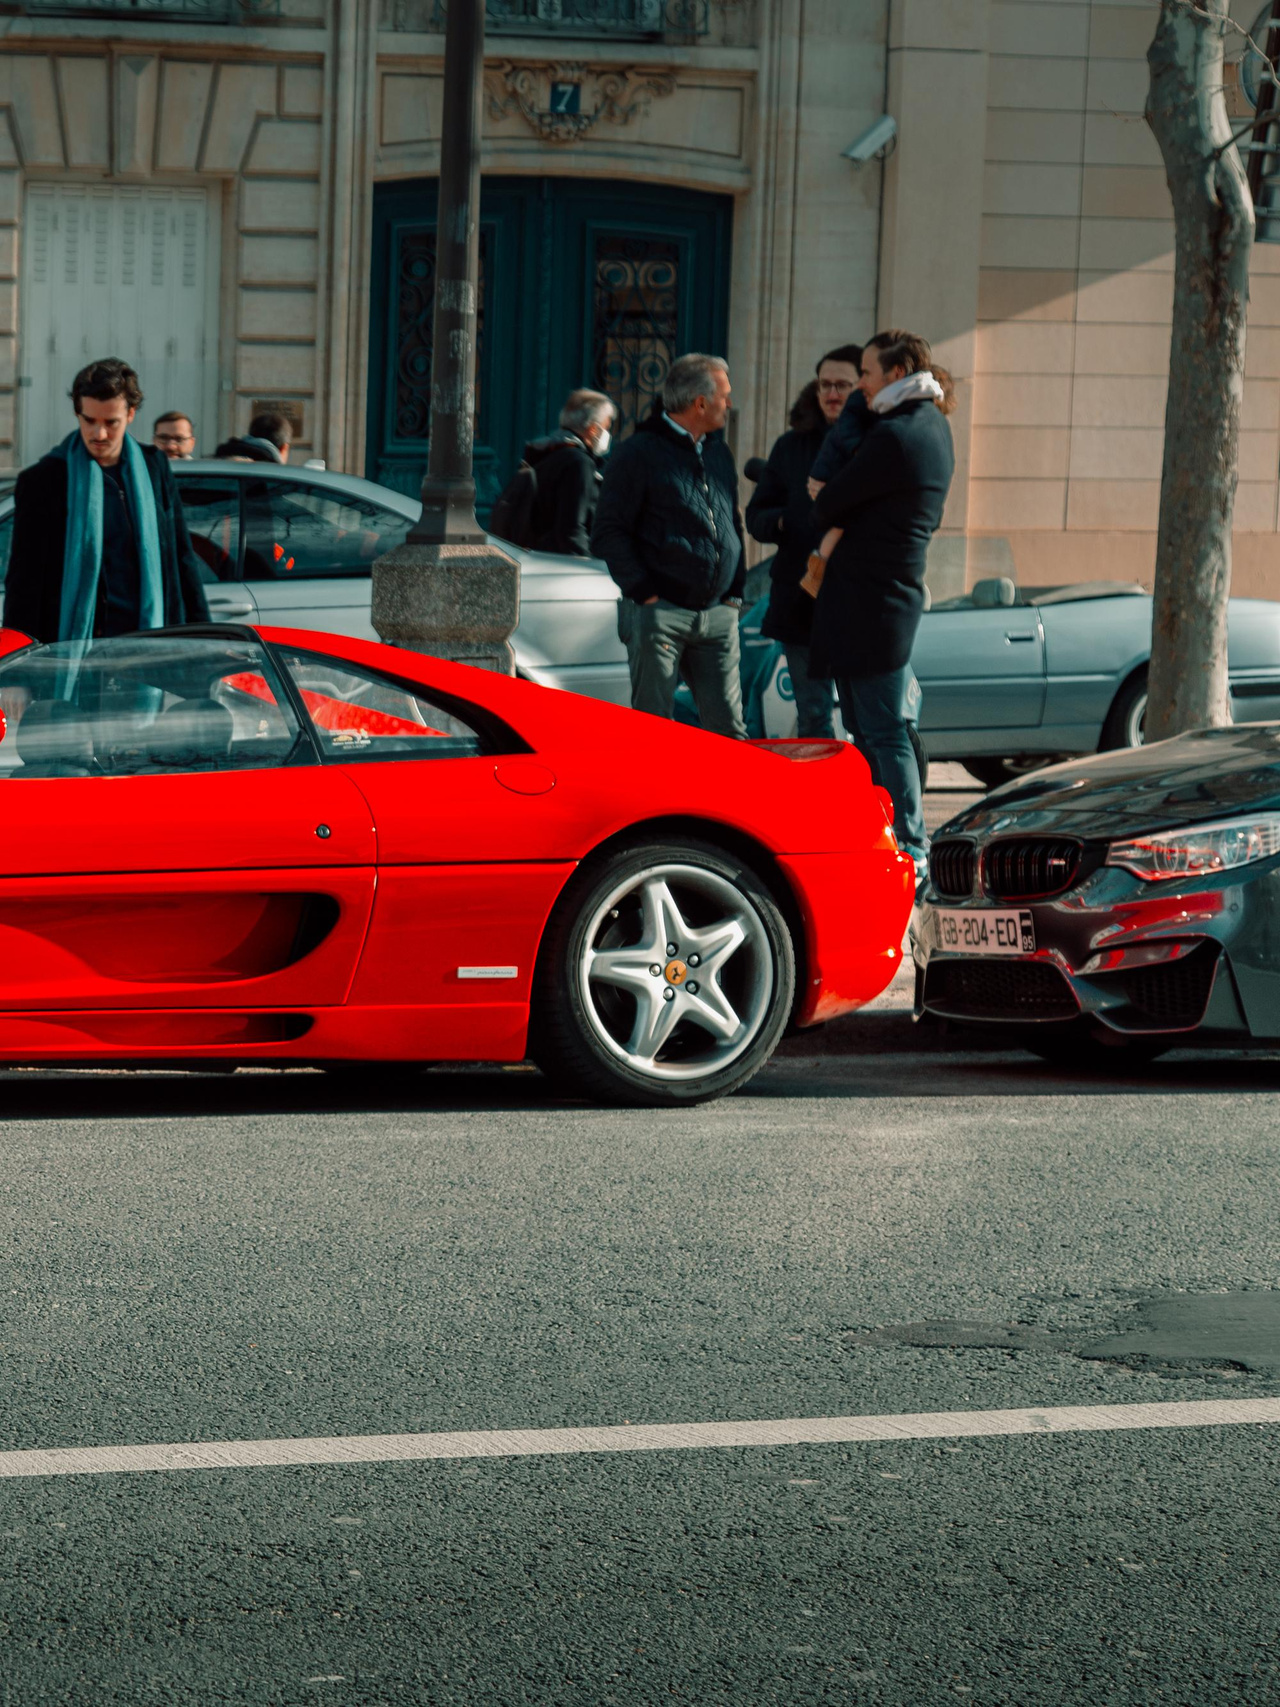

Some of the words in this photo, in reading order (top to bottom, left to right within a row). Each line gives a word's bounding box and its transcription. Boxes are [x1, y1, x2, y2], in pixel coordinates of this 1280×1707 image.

[557, 84, 574, 112] 7
[942, 917, 1018, 948] GB-204-EQ
[1022, 935, 1033, 950] 95
